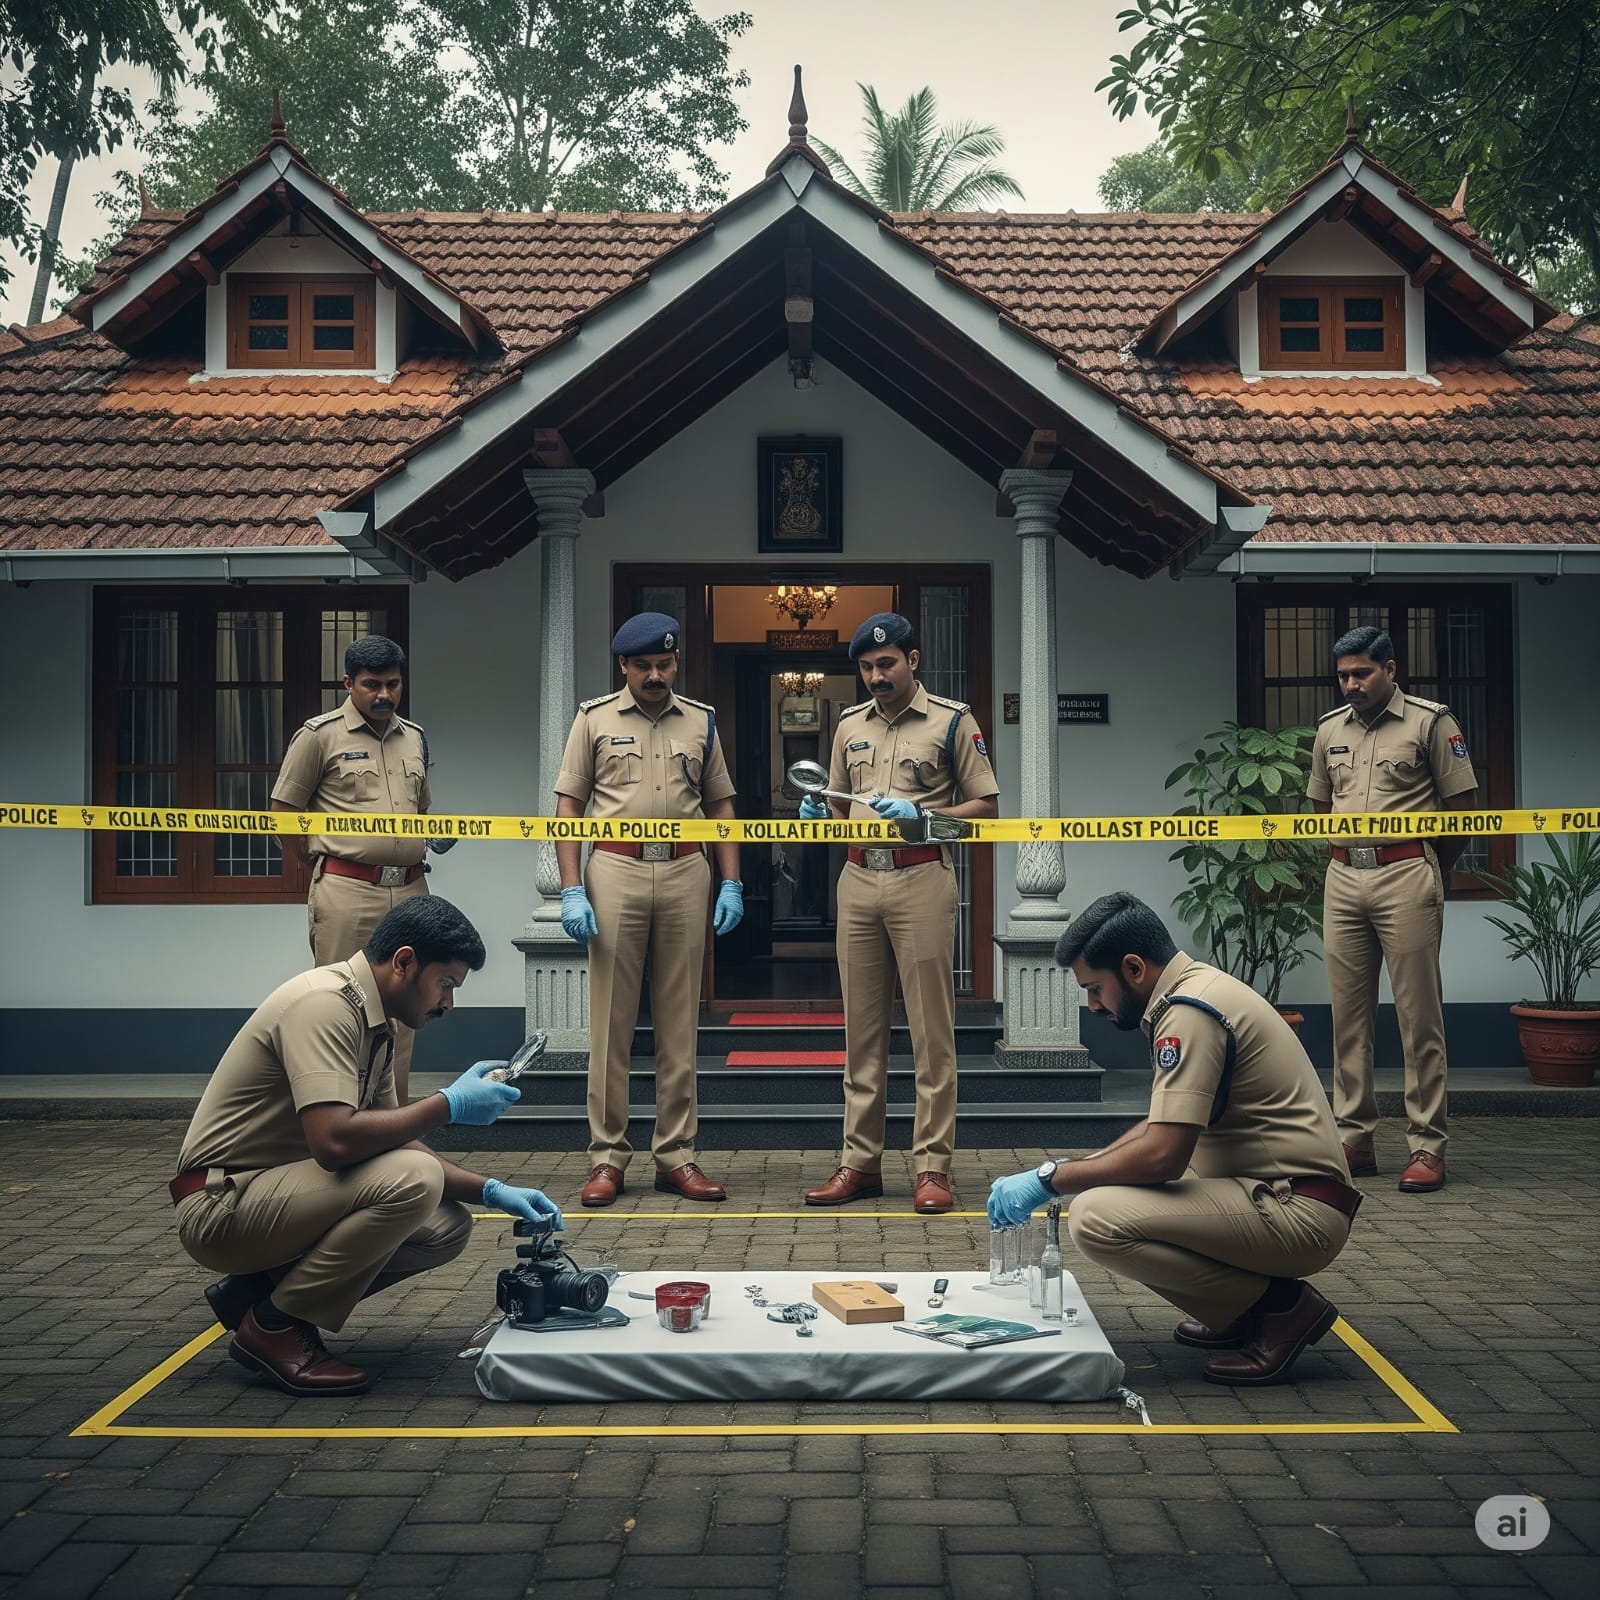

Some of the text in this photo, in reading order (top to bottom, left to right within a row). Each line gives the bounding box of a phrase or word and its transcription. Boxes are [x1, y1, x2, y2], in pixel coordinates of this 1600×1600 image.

[0, 808, 57, 825] POLICE
[546, 821, 681, 839] KOLLAA POLICE
[1060, 820, 1219, 838] KOLLAST POLICE
